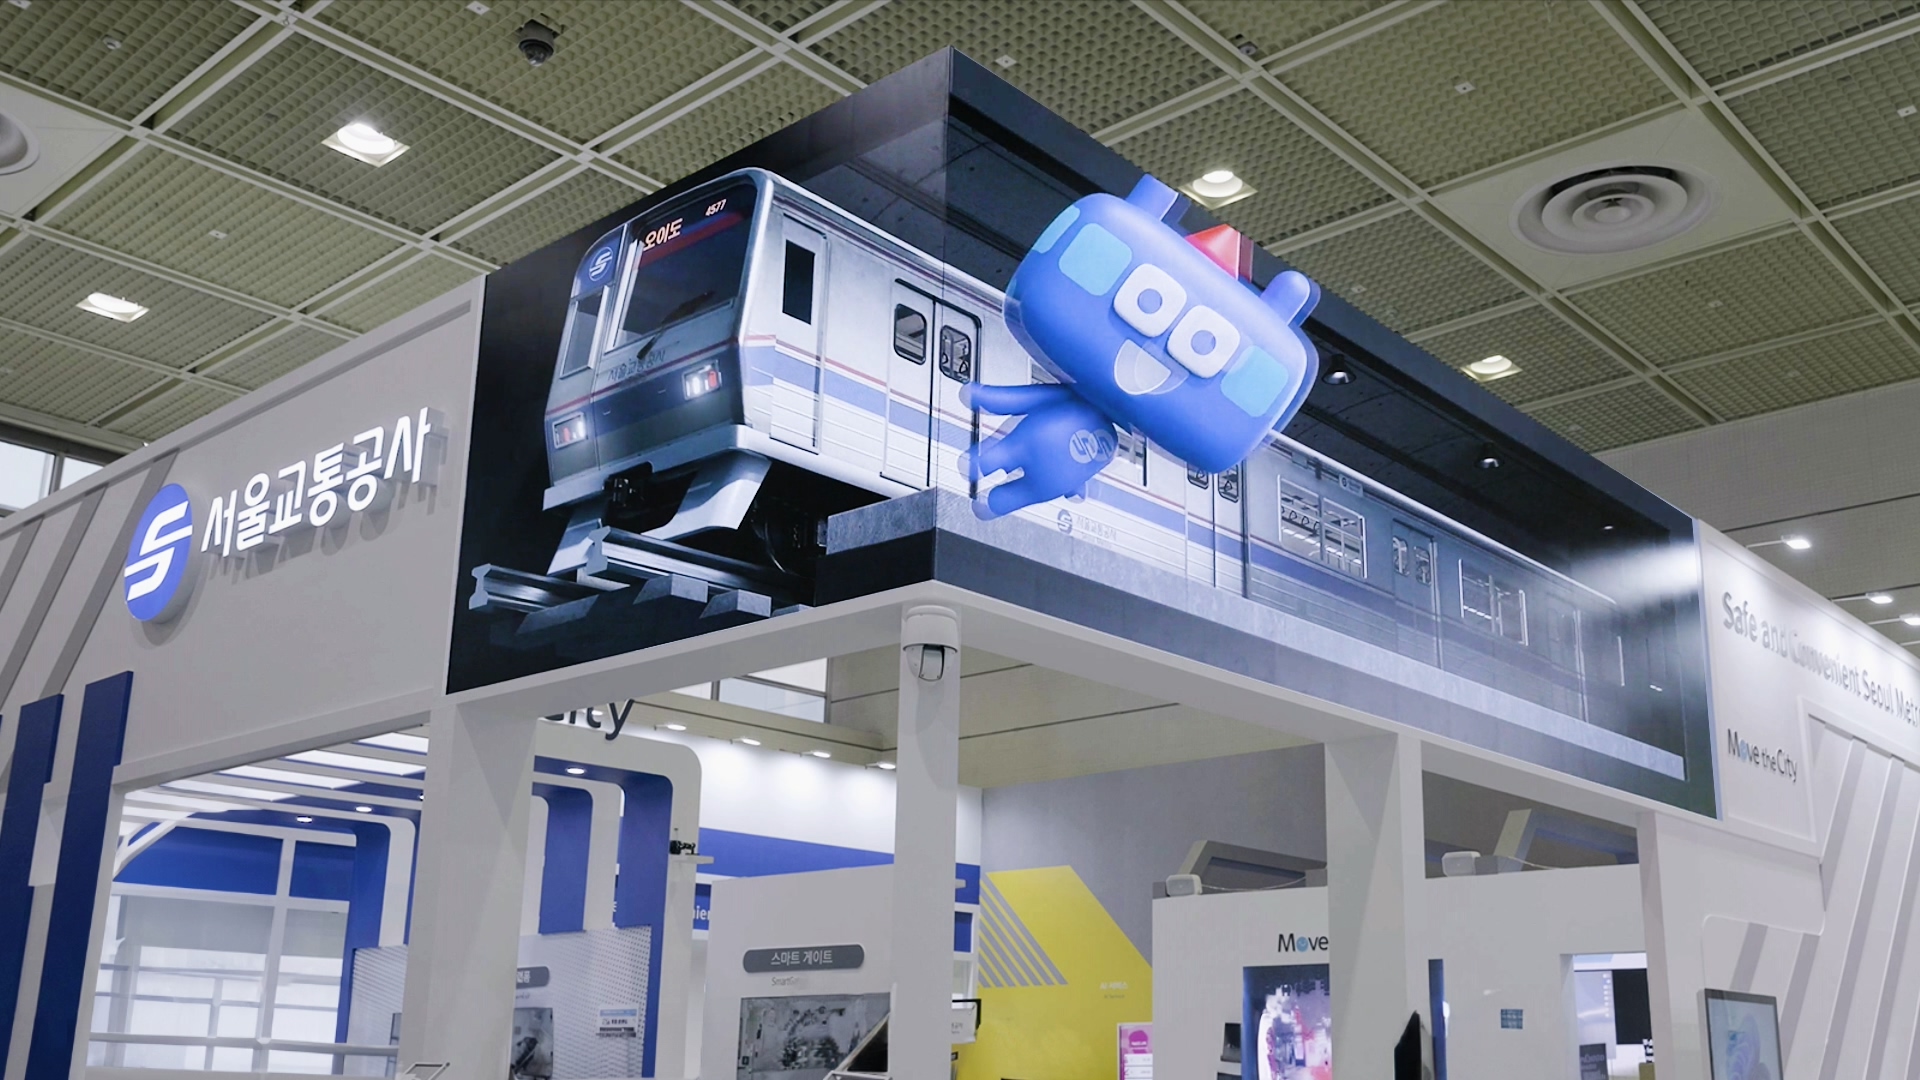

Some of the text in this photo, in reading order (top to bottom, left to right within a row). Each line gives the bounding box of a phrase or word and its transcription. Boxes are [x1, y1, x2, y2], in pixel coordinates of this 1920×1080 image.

[705, 198, 727, 216] 4577
[643, 217, 683, 252] 오이도
[200, 406, 432, 558] 서울교통공사
[1722, 591, 1758, 643] Safe
[1861, 669, 1895, 715] Seoul
[1894, 687, 1920, 728] Metr
[544, 698, 634, 741] ty
[1727, 728, 1760, 766] Move
[770, 949, 833, 967] 스마트 게이트
[1278, 932, 1329, 954] Move
